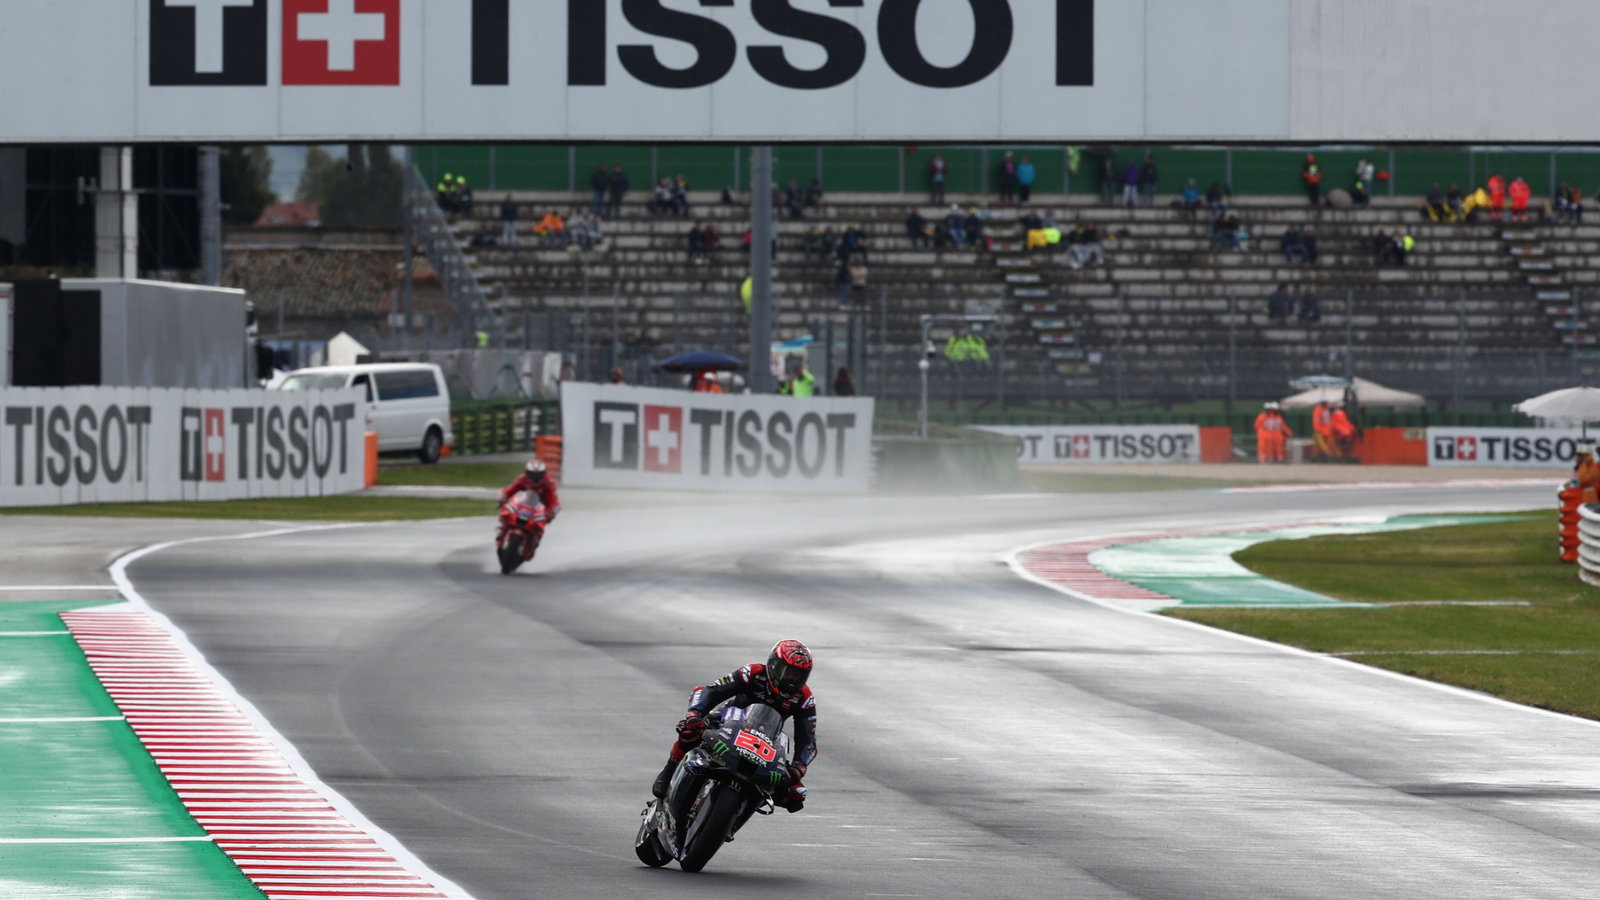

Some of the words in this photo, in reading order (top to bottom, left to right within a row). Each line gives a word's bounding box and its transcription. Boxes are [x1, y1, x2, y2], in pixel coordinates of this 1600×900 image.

[6, 405, 152, 487] TISSOT
[231, 403, 356, 480] TISSOT
[690, 407, 856, 478] TISSOT
[1093, 434, 1193, 458] TISSOT
[735, 730, 777, 762] 20
